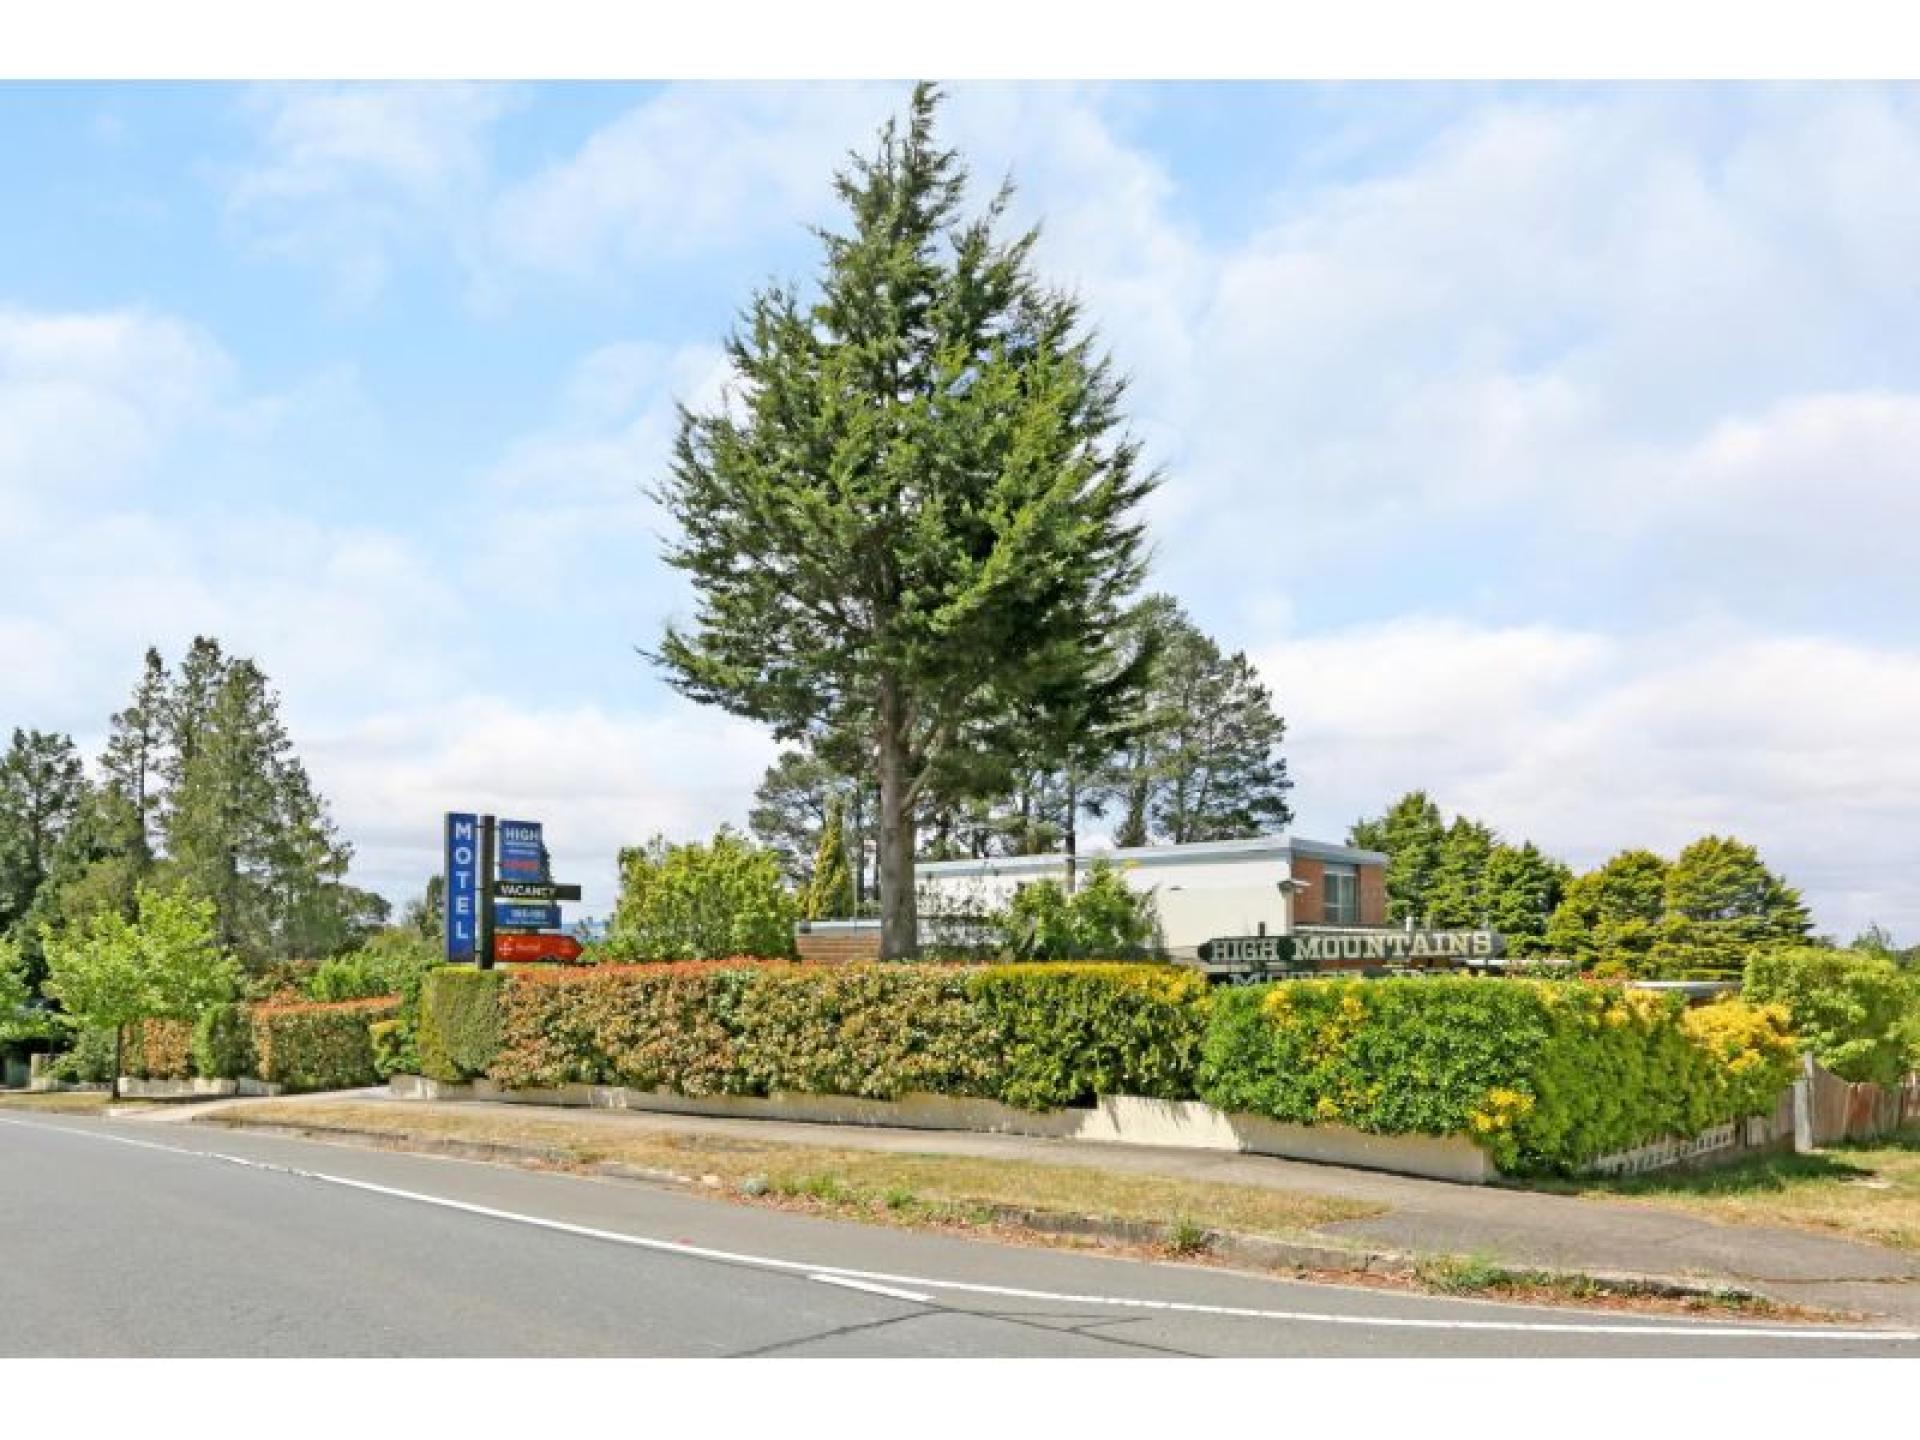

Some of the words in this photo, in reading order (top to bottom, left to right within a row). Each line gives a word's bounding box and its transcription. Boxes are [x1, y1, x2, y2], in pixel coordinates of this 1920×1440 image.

[504, 827, 539, 841] HIGH
[455, 822, 471, 939] MOTEL
[501, 885, 556, 897] VACANCY
[1211, 939, 1280, 961] HIGH
[1293, 931, 1492, 961] MOUNTAINS
